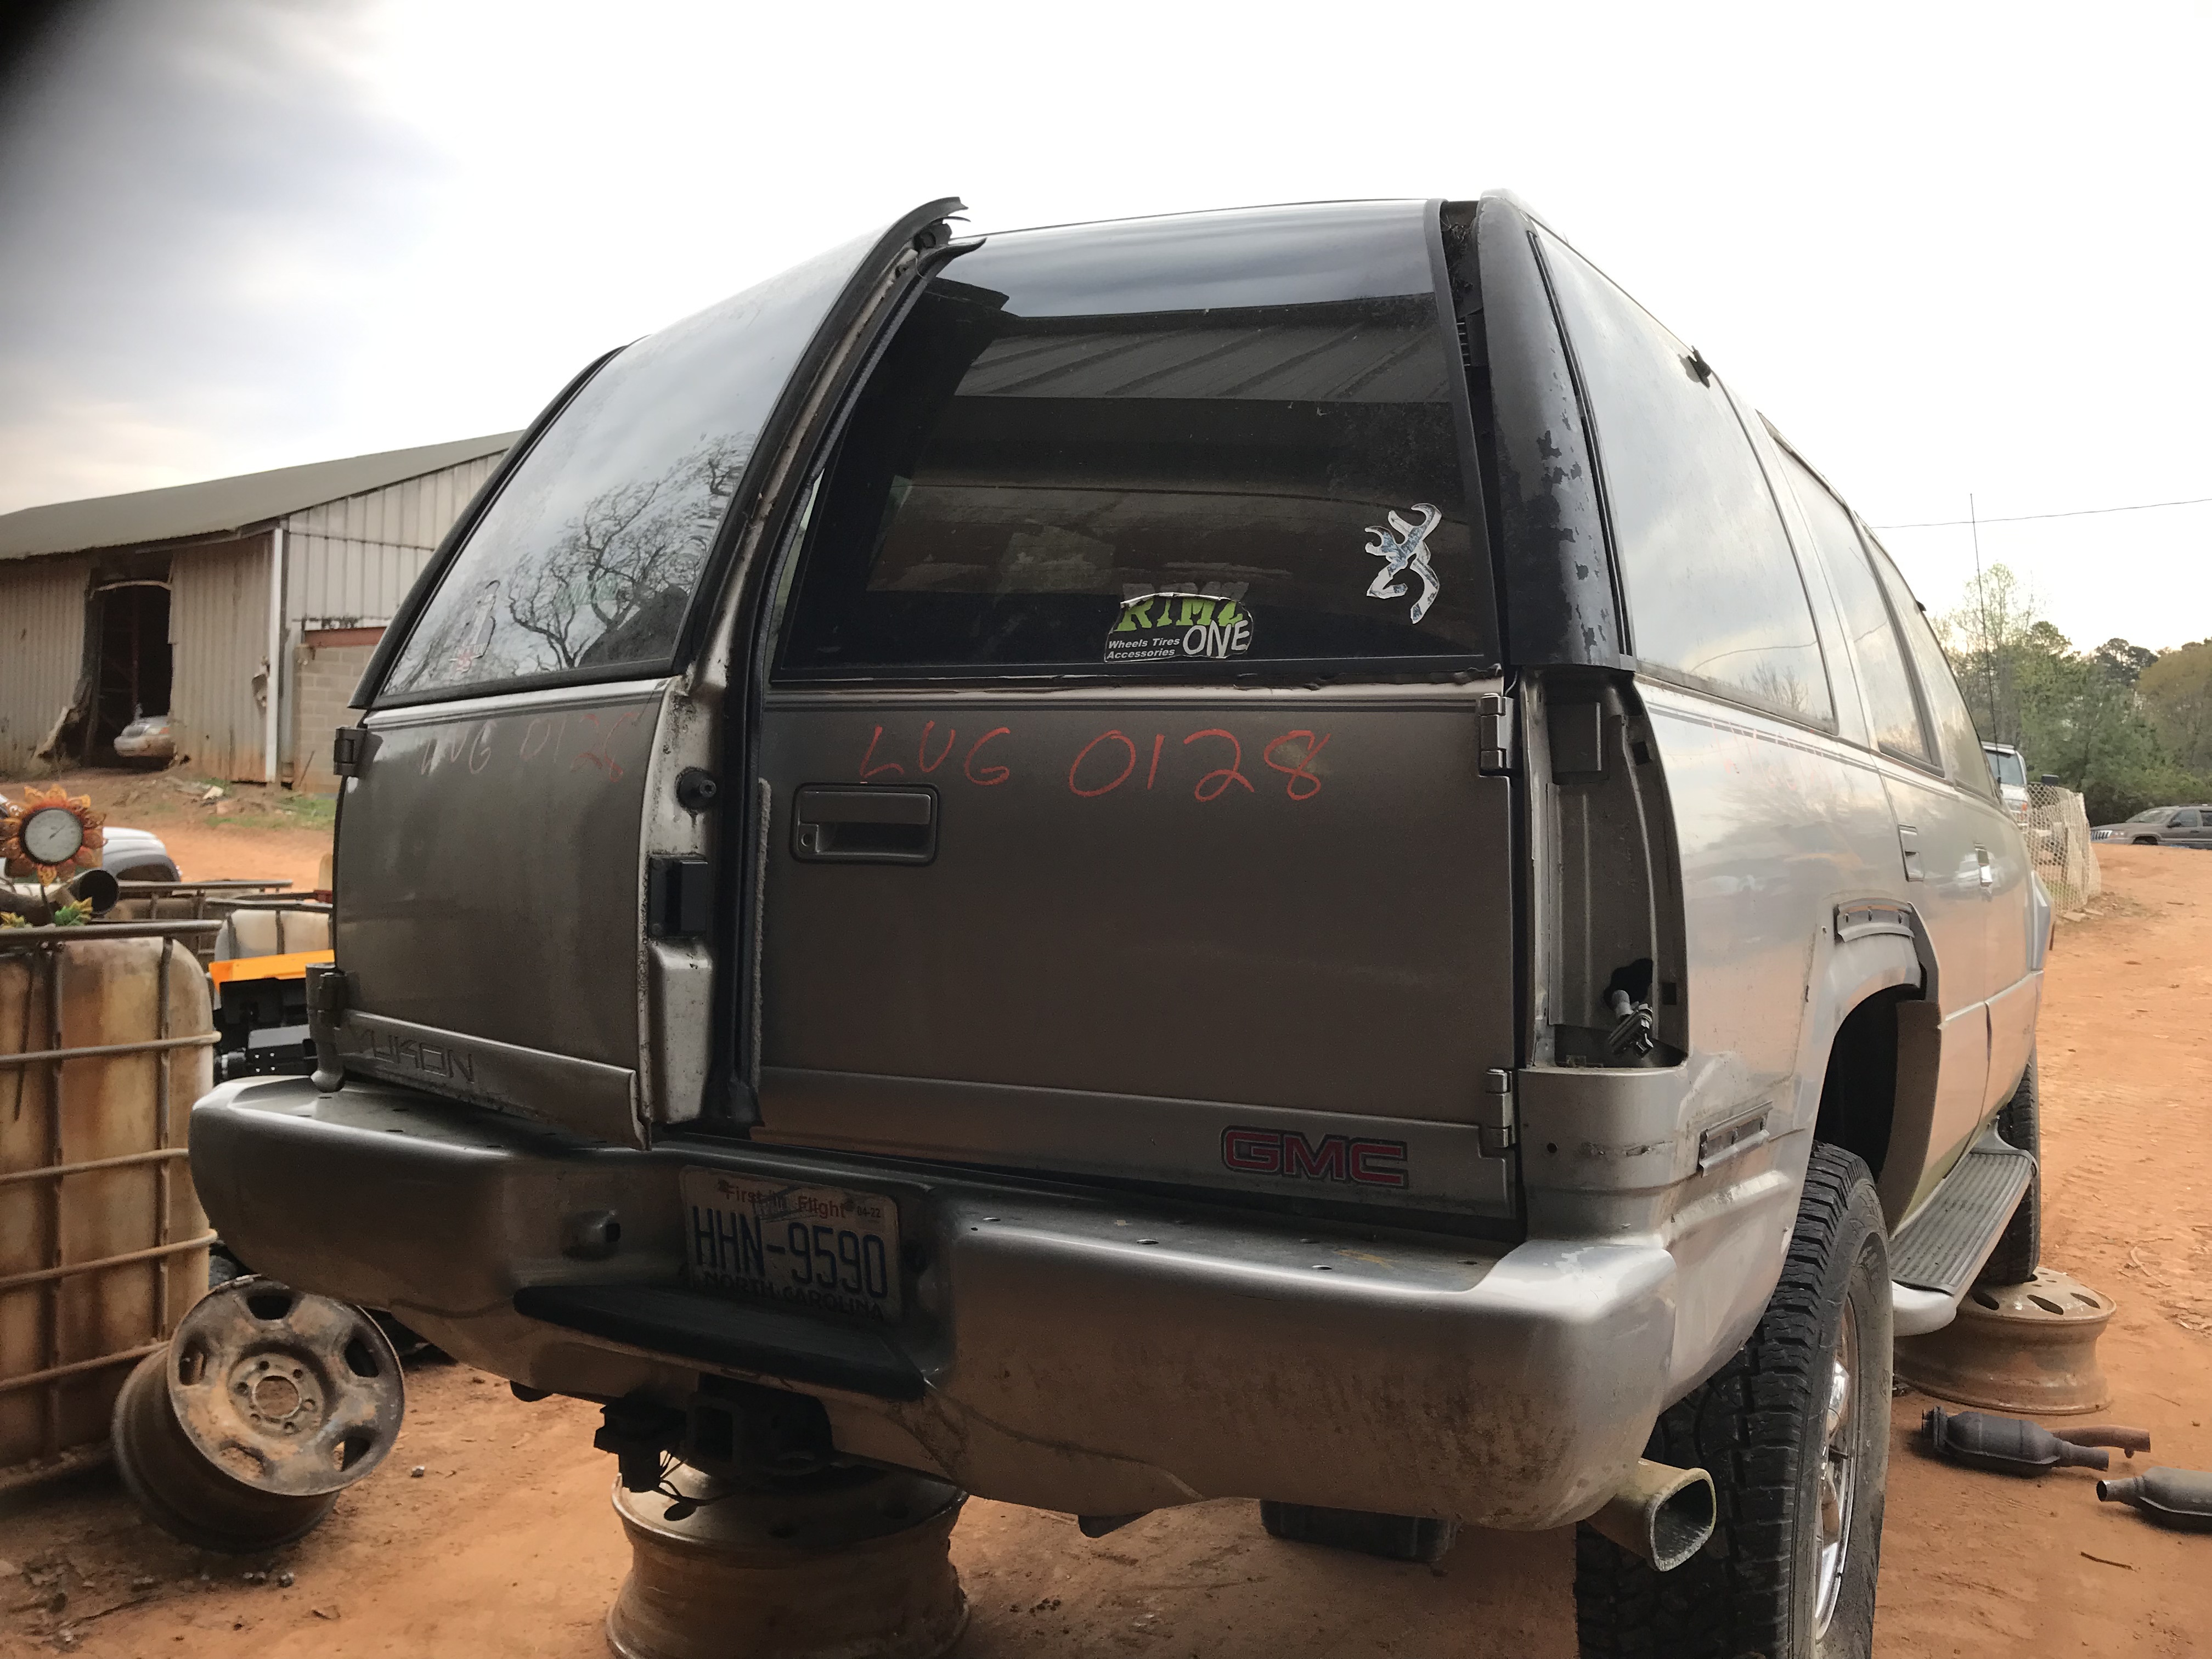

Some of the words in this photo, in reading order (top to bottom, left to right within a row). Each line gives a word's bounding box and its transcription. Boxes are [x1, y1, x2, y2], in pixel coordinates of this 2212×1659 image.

[1107, 648, 1175, 659] Accessories
[1108, 638, 1148, 648] Wheels
[1153, 637, 1180, 646] Tires
[1183, 619, 1249, 658] ONE
[860, 721, 1011, 785] LUG
[1069, 729, 1331, 802] 0128
[1223, 1127, 1407, 1188] GMC
[726, 1185, 763, 1204] First
[798, 1195, 847, 1219] Flight
[692, 1205, 888, 1299] HHN-9590
